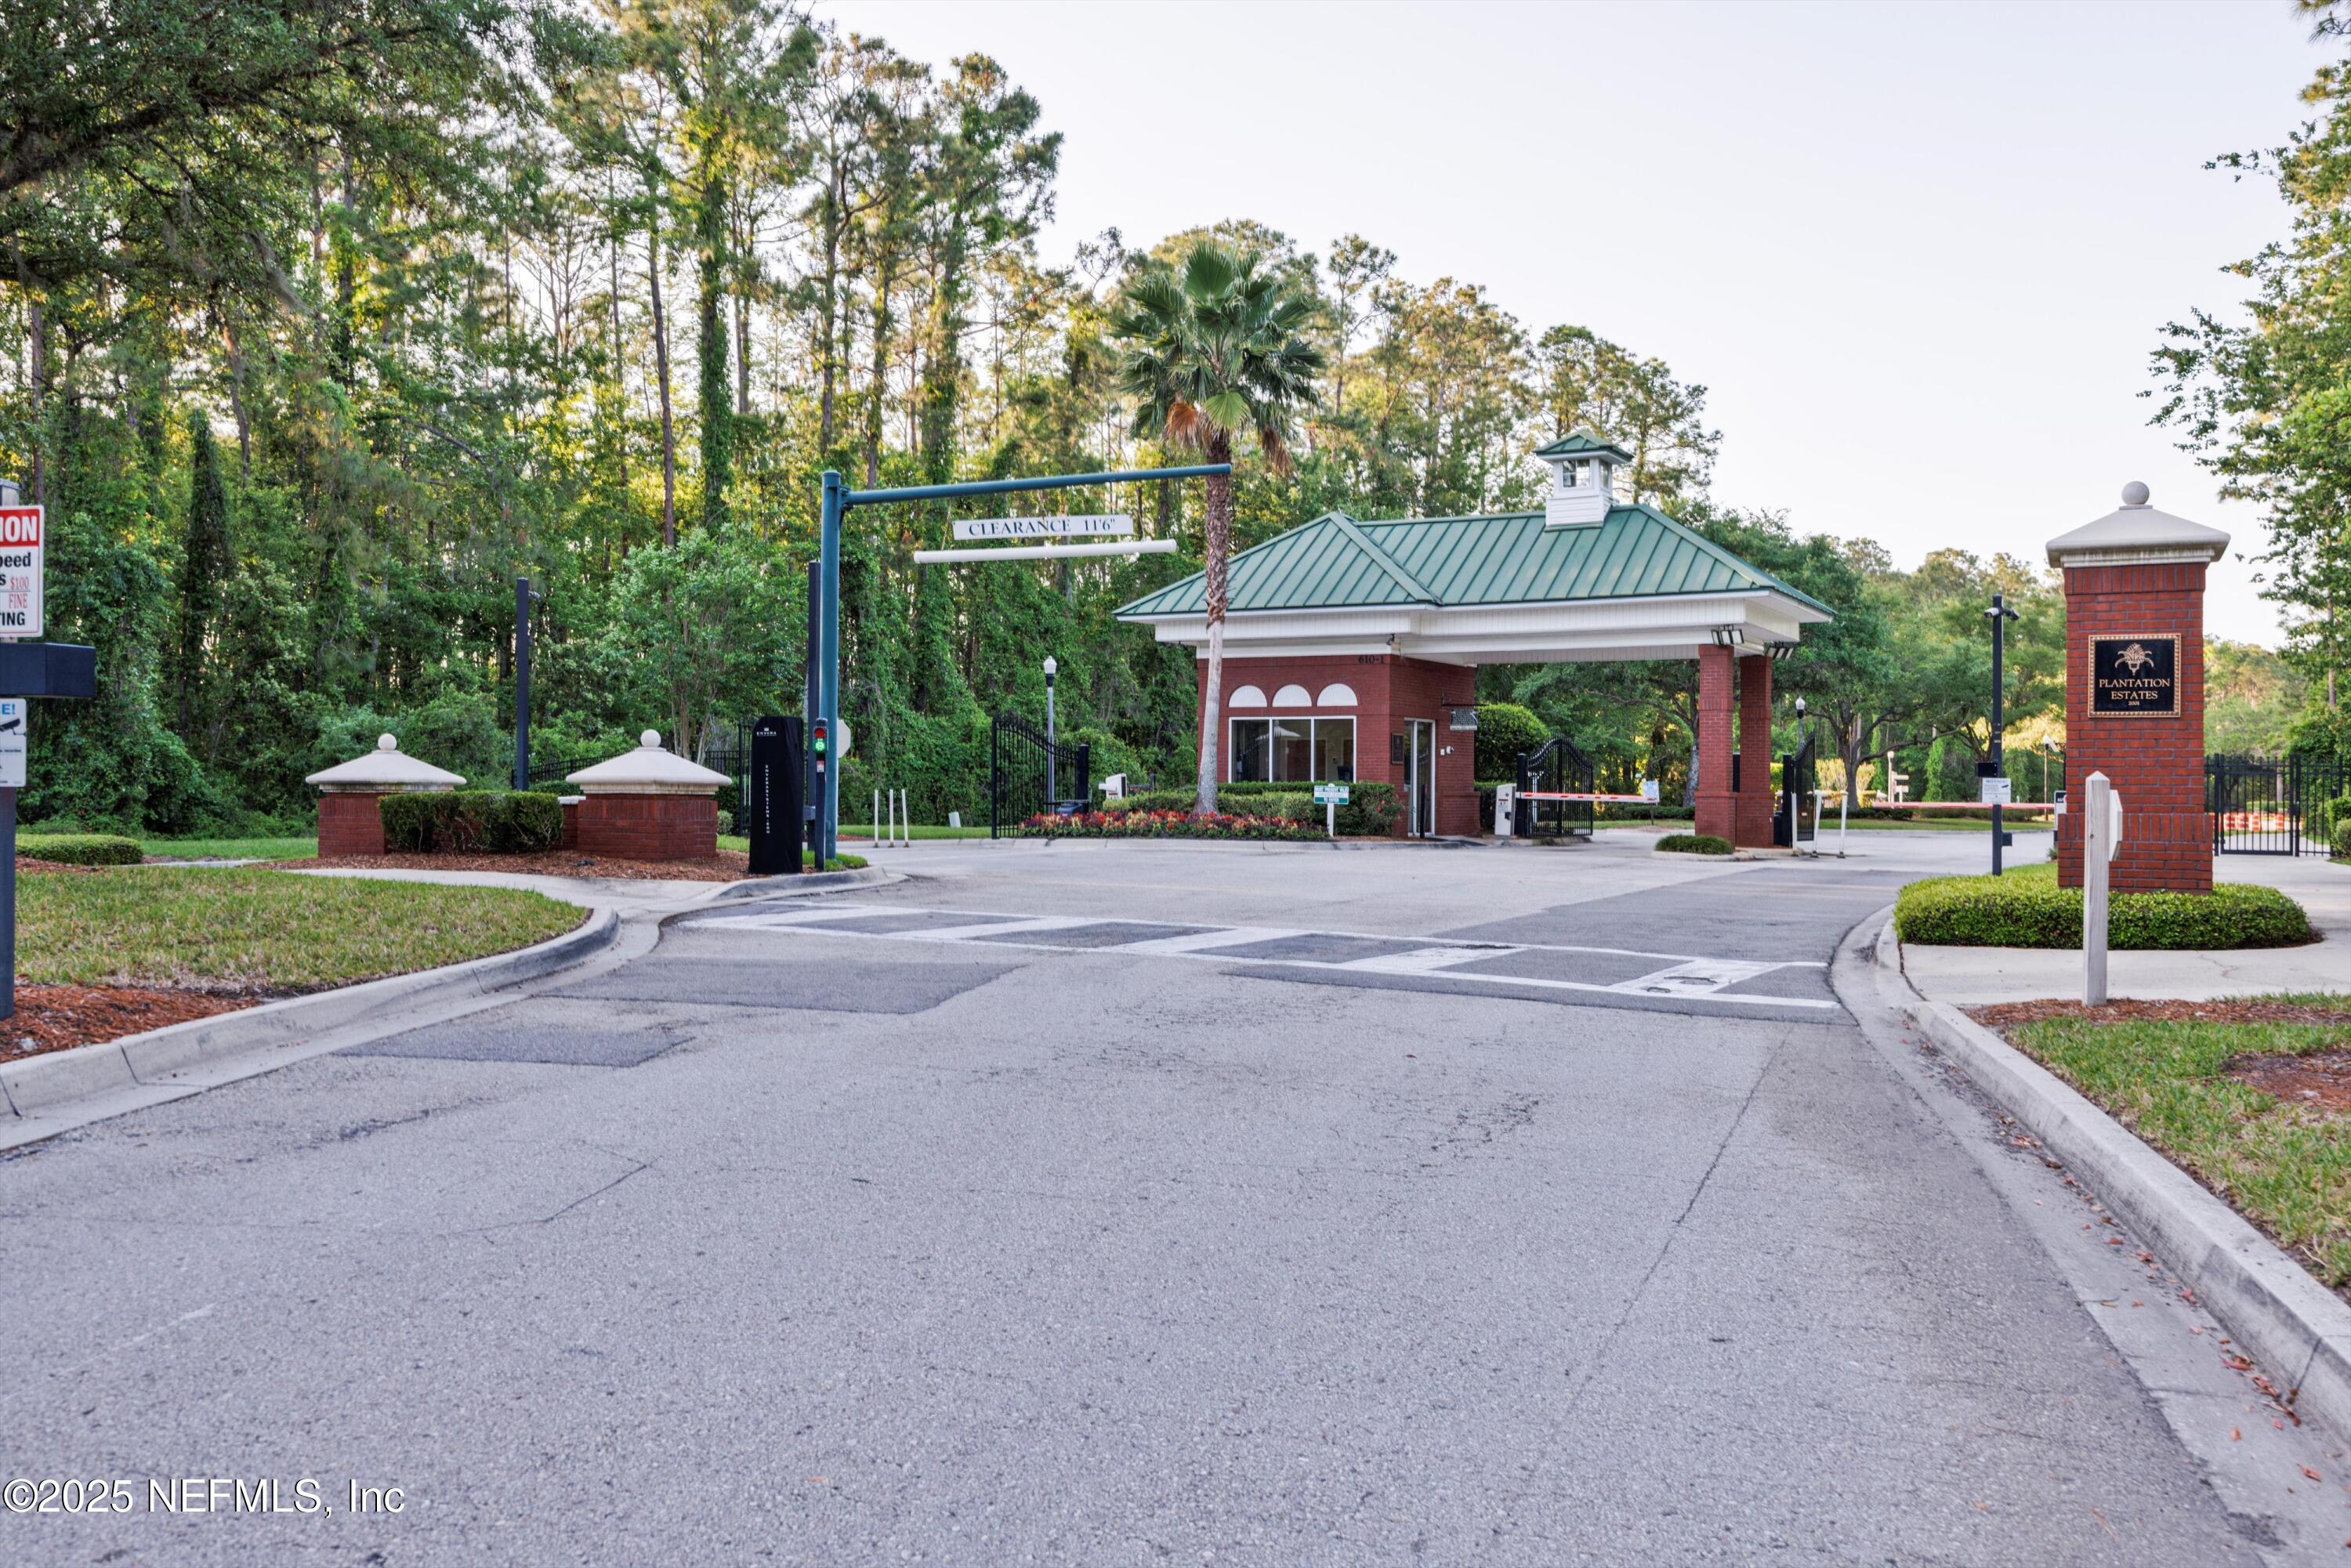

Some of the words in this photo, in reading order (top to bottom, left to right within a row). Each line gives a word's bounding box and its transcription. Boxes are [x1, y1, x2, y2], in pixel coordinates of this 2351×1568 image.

[969, 519, 1070, 536] CLEARANCE
[9, 575, 30, 590] $100
[9, 592, 28, 609] FINE
[0, 611, 26, 626] ING
[1357, 654, 1386, 664] 610-1
[2099, 679, 2170, 688] PLANTATION
[2111, 690, 2158, 700] ESTATES
